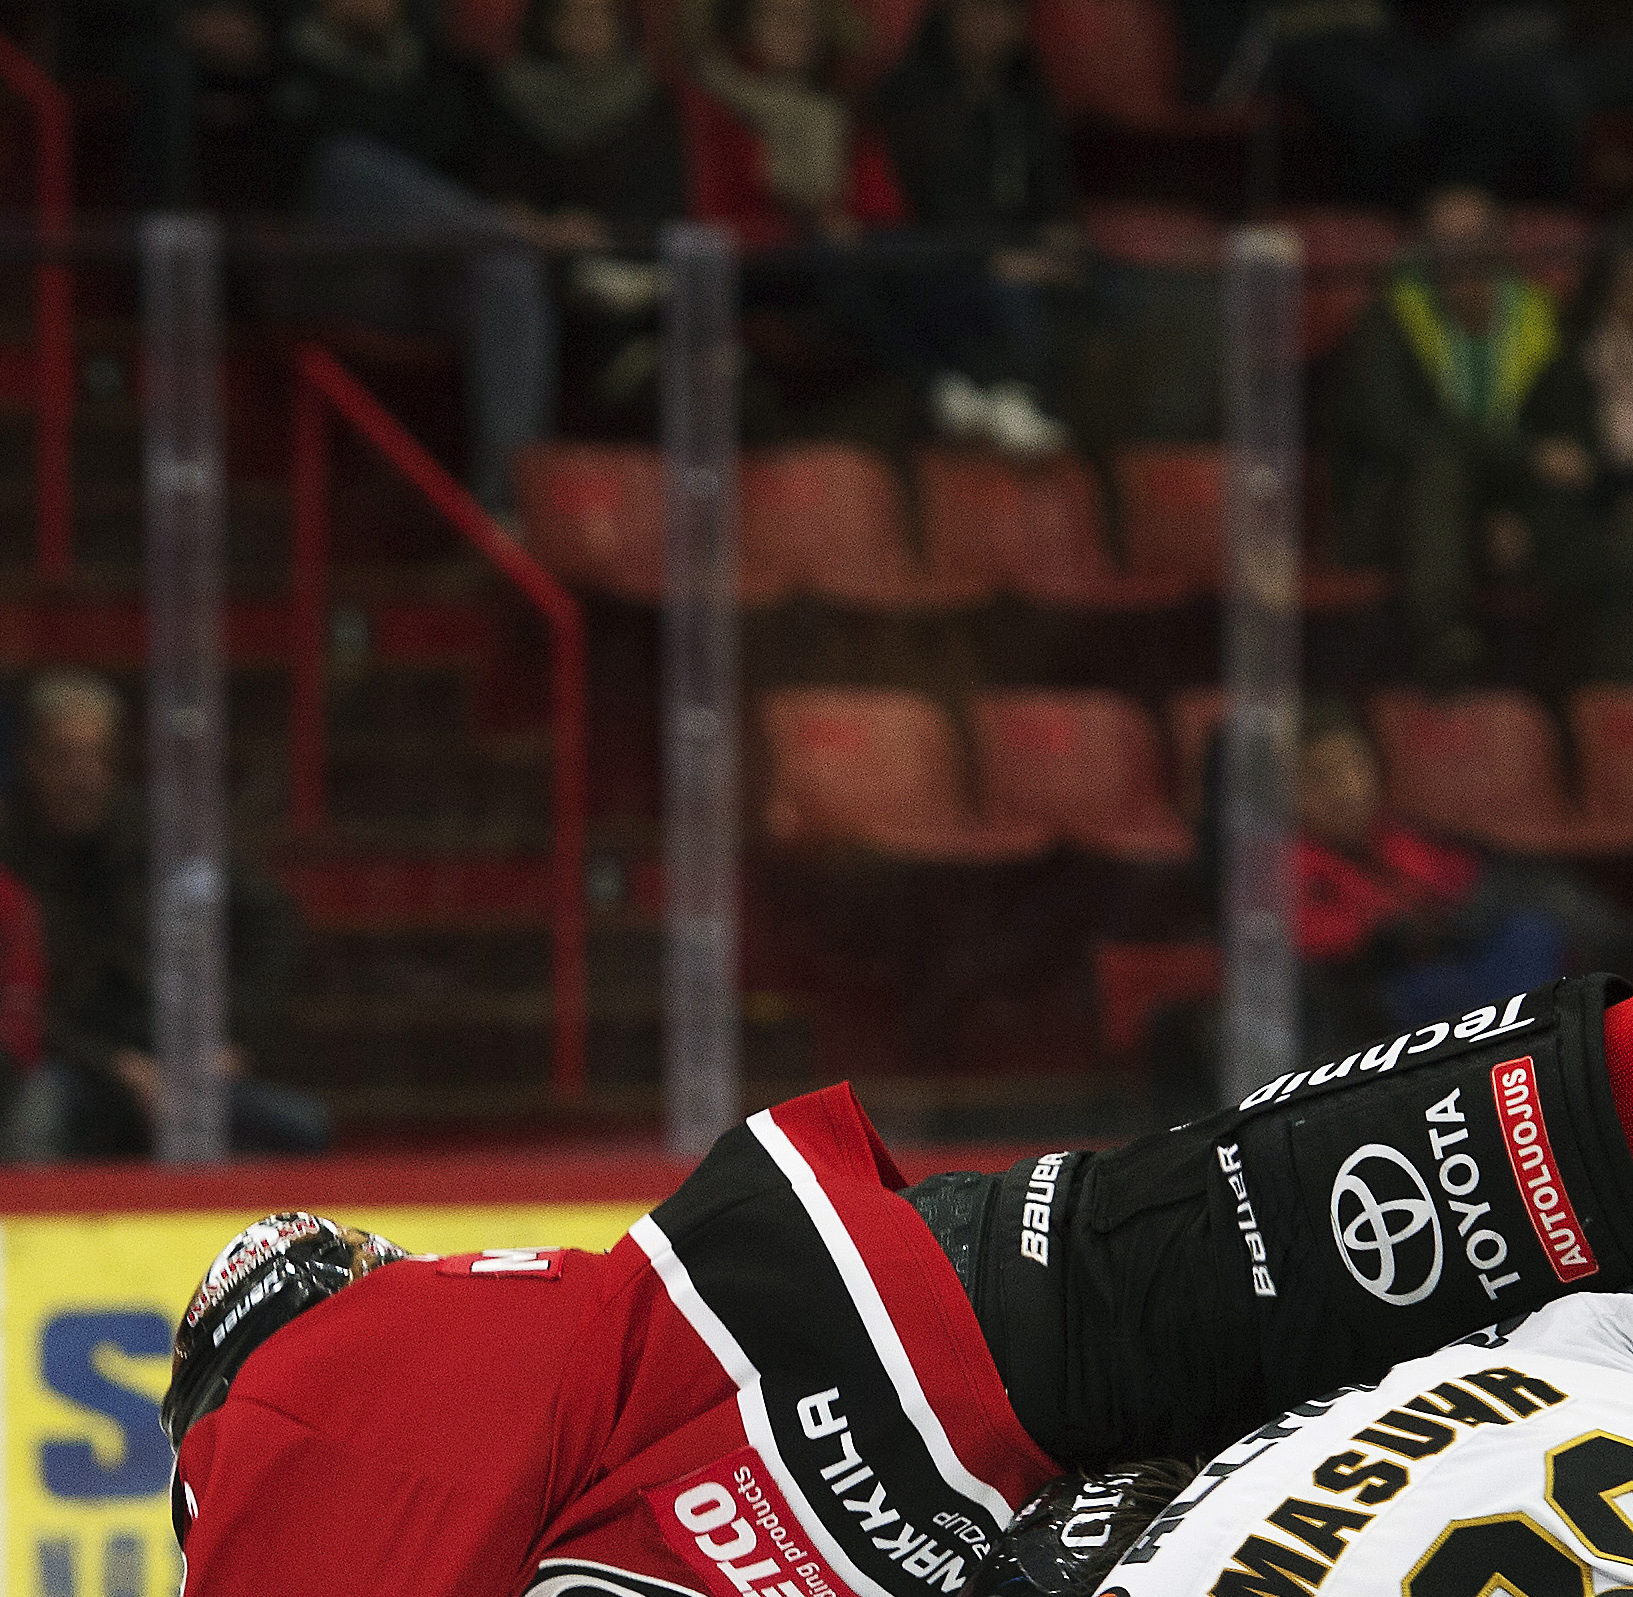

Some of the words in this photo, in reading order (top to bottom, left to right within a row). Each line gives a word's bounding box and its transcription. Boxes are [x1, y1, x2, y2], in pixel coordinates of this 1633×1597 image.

[1240, 993, 1535, 1112] Technip
[1425, 1087, 1521, 1300] TOYOTA
[1502, 1067, 1588, 1266] AUTOLUOJUS
[733, 1465, 806, 1564] products
[797, 1386, 968, 1595] NAKKILA
[932, 1511, 992, 1561] ROUP
